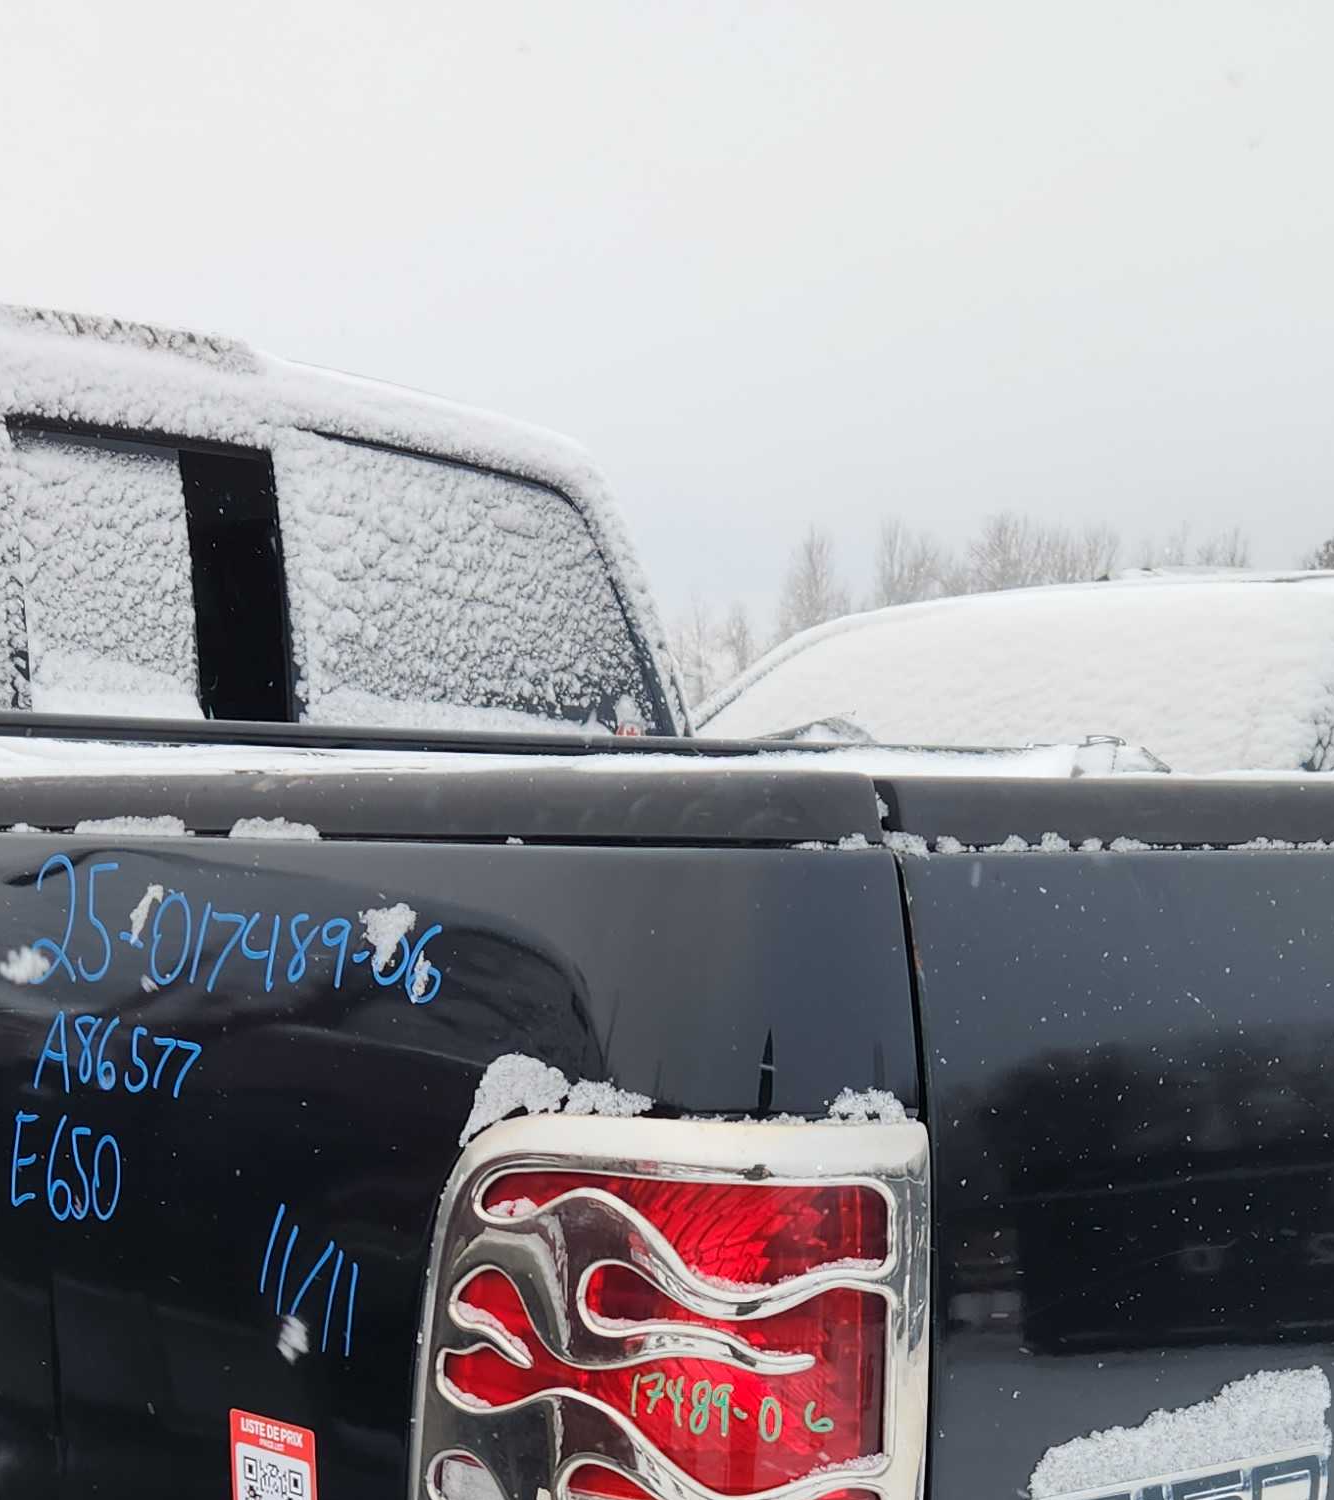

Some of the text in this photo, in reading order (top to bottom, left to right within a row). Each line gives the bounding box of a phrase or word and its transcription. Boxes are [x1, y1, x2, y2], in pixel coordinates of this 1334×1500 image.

[32, 1010, 203, 1099] A86577
[11, 1109, 123, 1222] E650
[259, 1203, 359, 1357] 11/11
[240, 1416, 303, 1448] LISTE DE PRIX
